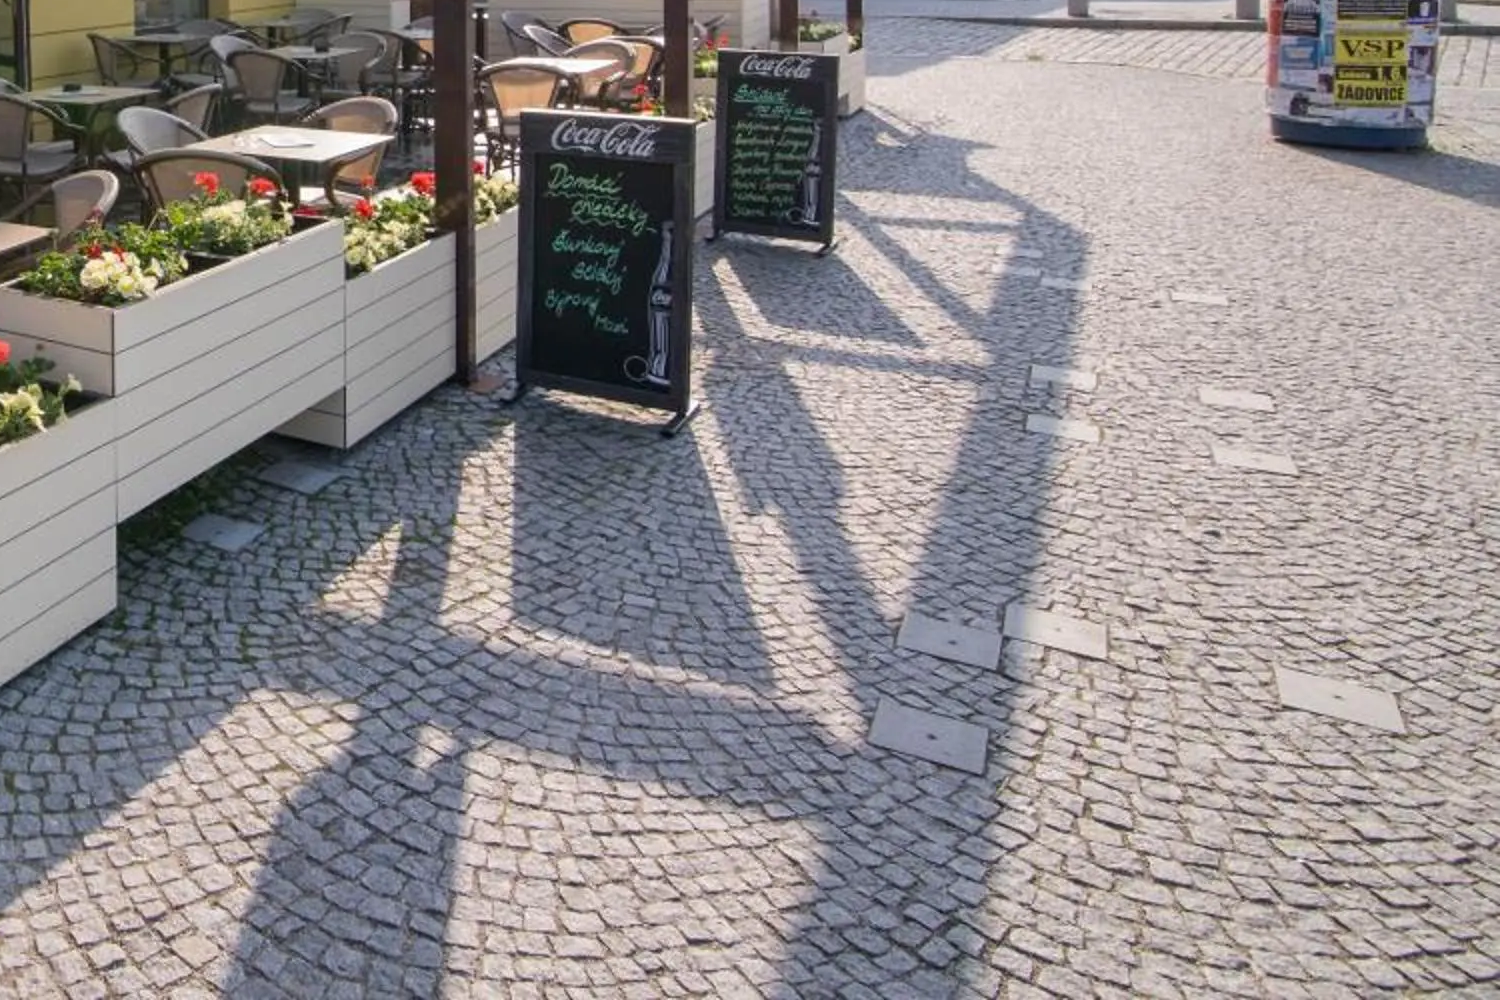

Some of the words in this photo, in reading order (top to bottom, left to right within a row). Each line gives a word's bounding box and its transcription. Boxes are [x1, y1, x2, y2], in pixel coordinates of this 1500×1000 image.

[1340, 39, 1405, 58] VSP
[740, 54, 815, 80] Coca-Cola
[551, 118, 658, 158] Coca-Cola
